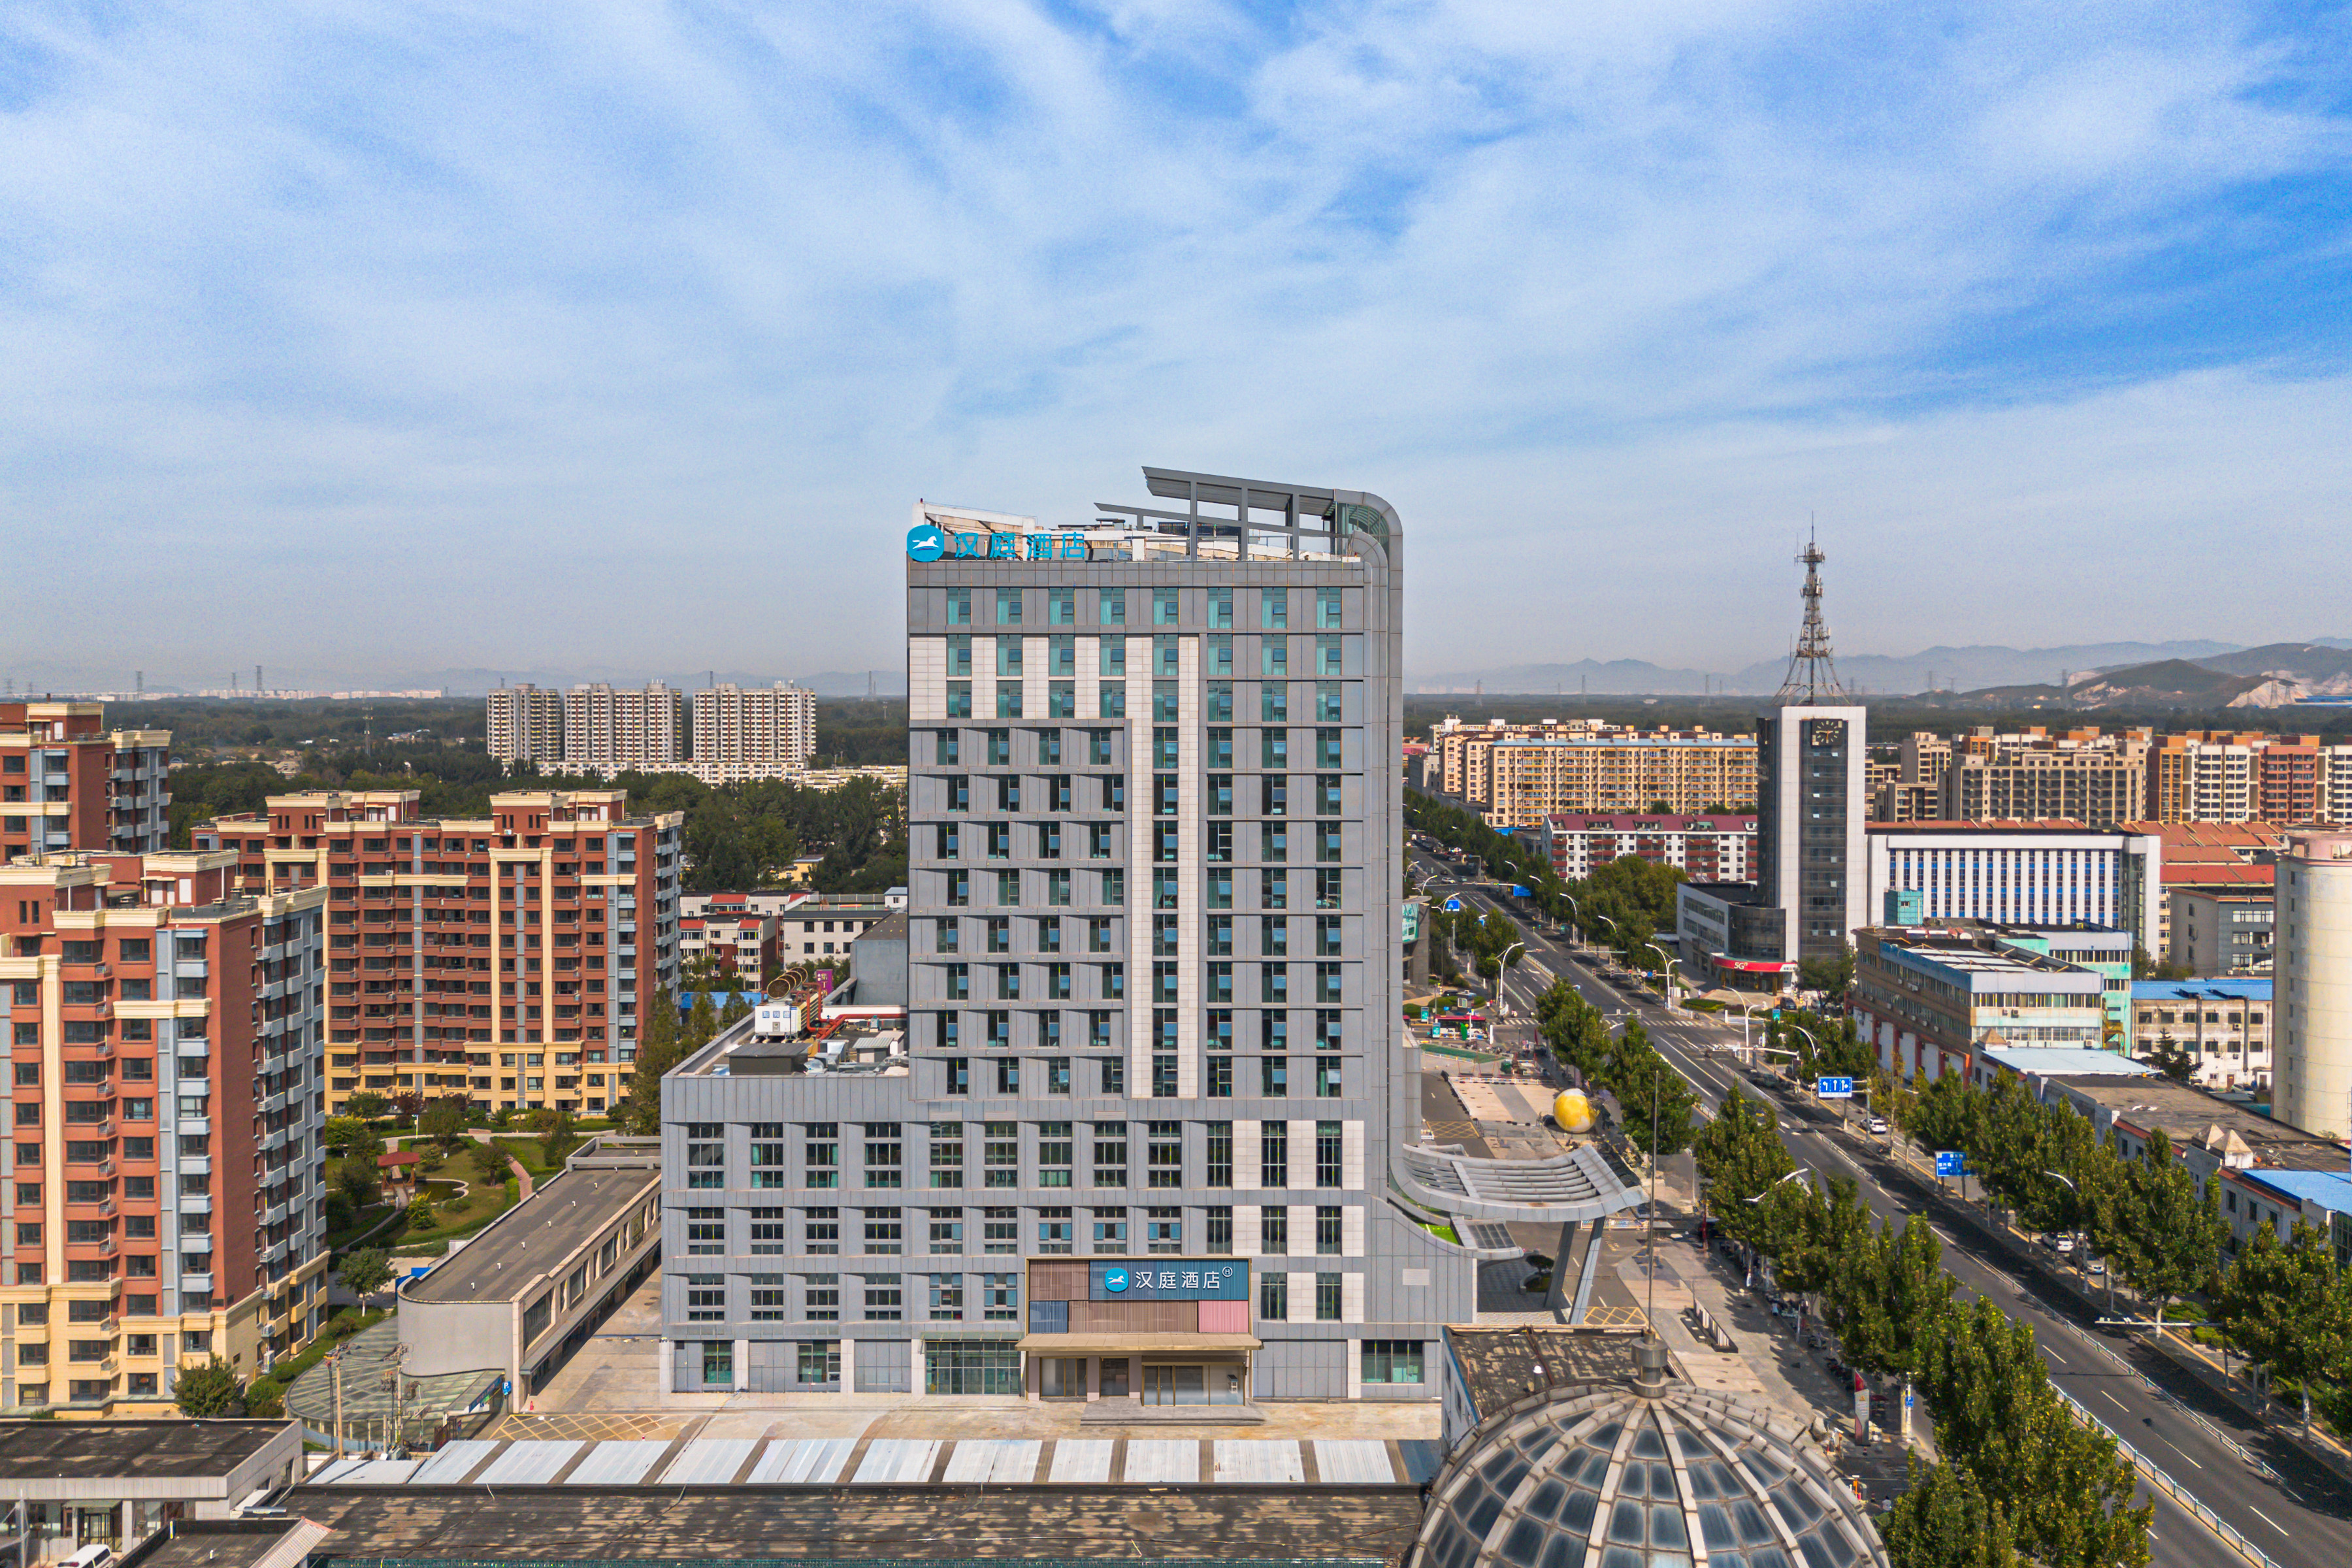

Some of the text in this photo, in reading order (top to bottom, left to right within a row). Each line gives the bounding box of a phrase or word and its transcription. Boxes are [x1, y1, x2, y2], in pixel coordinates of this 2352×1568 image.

[954, 531, 1085, 558] 汉庭酒店
[1135, 1271, 1220, 1290] 汉庭酒店
